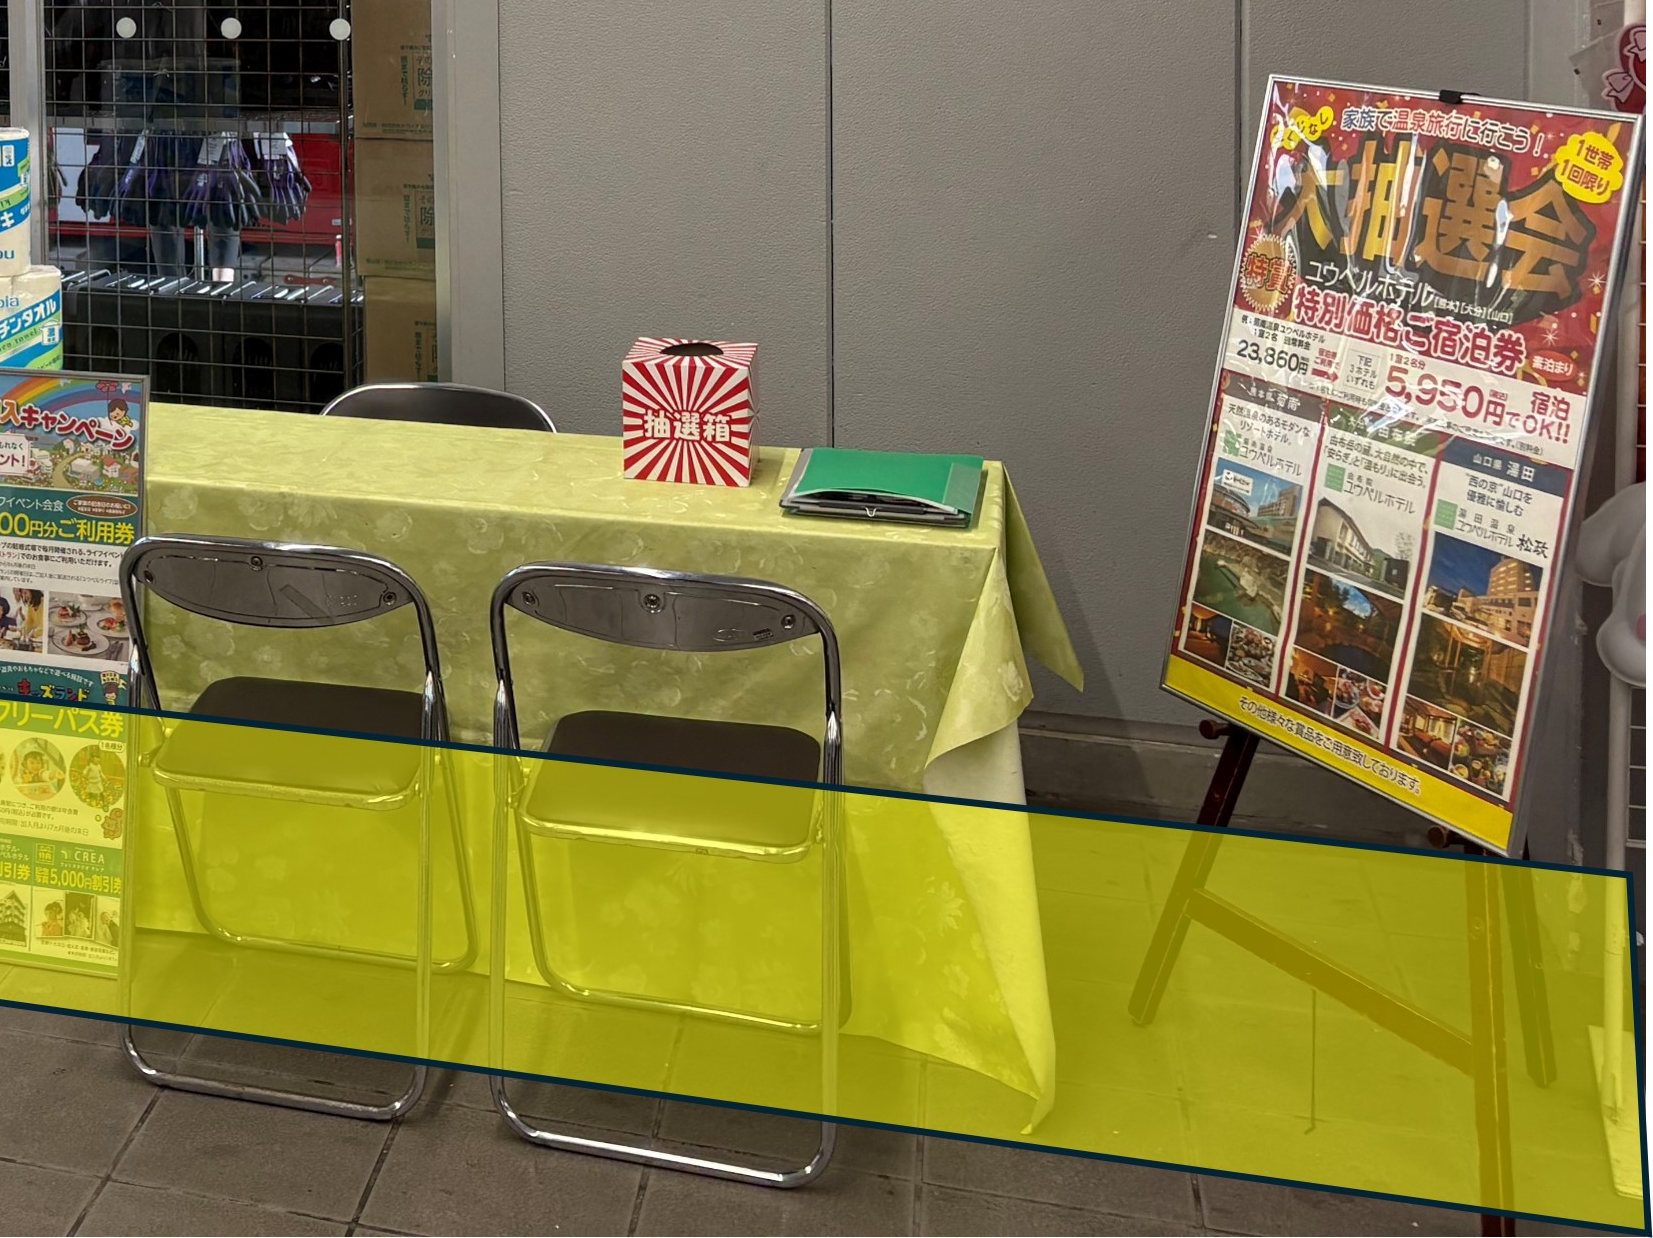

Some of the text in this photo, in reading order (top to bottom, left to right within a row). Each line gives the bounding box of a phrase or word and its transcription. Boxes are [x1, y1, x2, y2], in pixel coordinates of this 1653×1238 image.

[1341, 108, 1544, 157] 家族で温泉旅行に行こう!
[1577, 138, 1614, 171] 1世帯
[1559, 159, 1611, 196] 1回限り
[1274, 139, 1589, 300] 大抽選会
[1305, 261, 1434, 305] ユウベルホテル
[1294, 284, 1526, 374] 特別価格ご宿泊券
[1237, 339, 1309, 376] 23,860円
[1357, 354, 1372, 368] 下記
[1347, 375, 1376, 390] いずれも
[1228, 402, 1311, 438] 天然温泉のあるモダンな
[1531, 391, 1571, 421] 宿泊
[644, 409, 733, 443] 抽選箱
[1523, 414, 1571, 444] OK!!
[1344, 480, 1416, 514] ユウベルホテル
[1455, 519, 1514, 548] ユウベルホテル
[1239, 696, 1421, 796] その他様々な賞品をご用意致しております。
[74, 850, 106, 865] CREA
